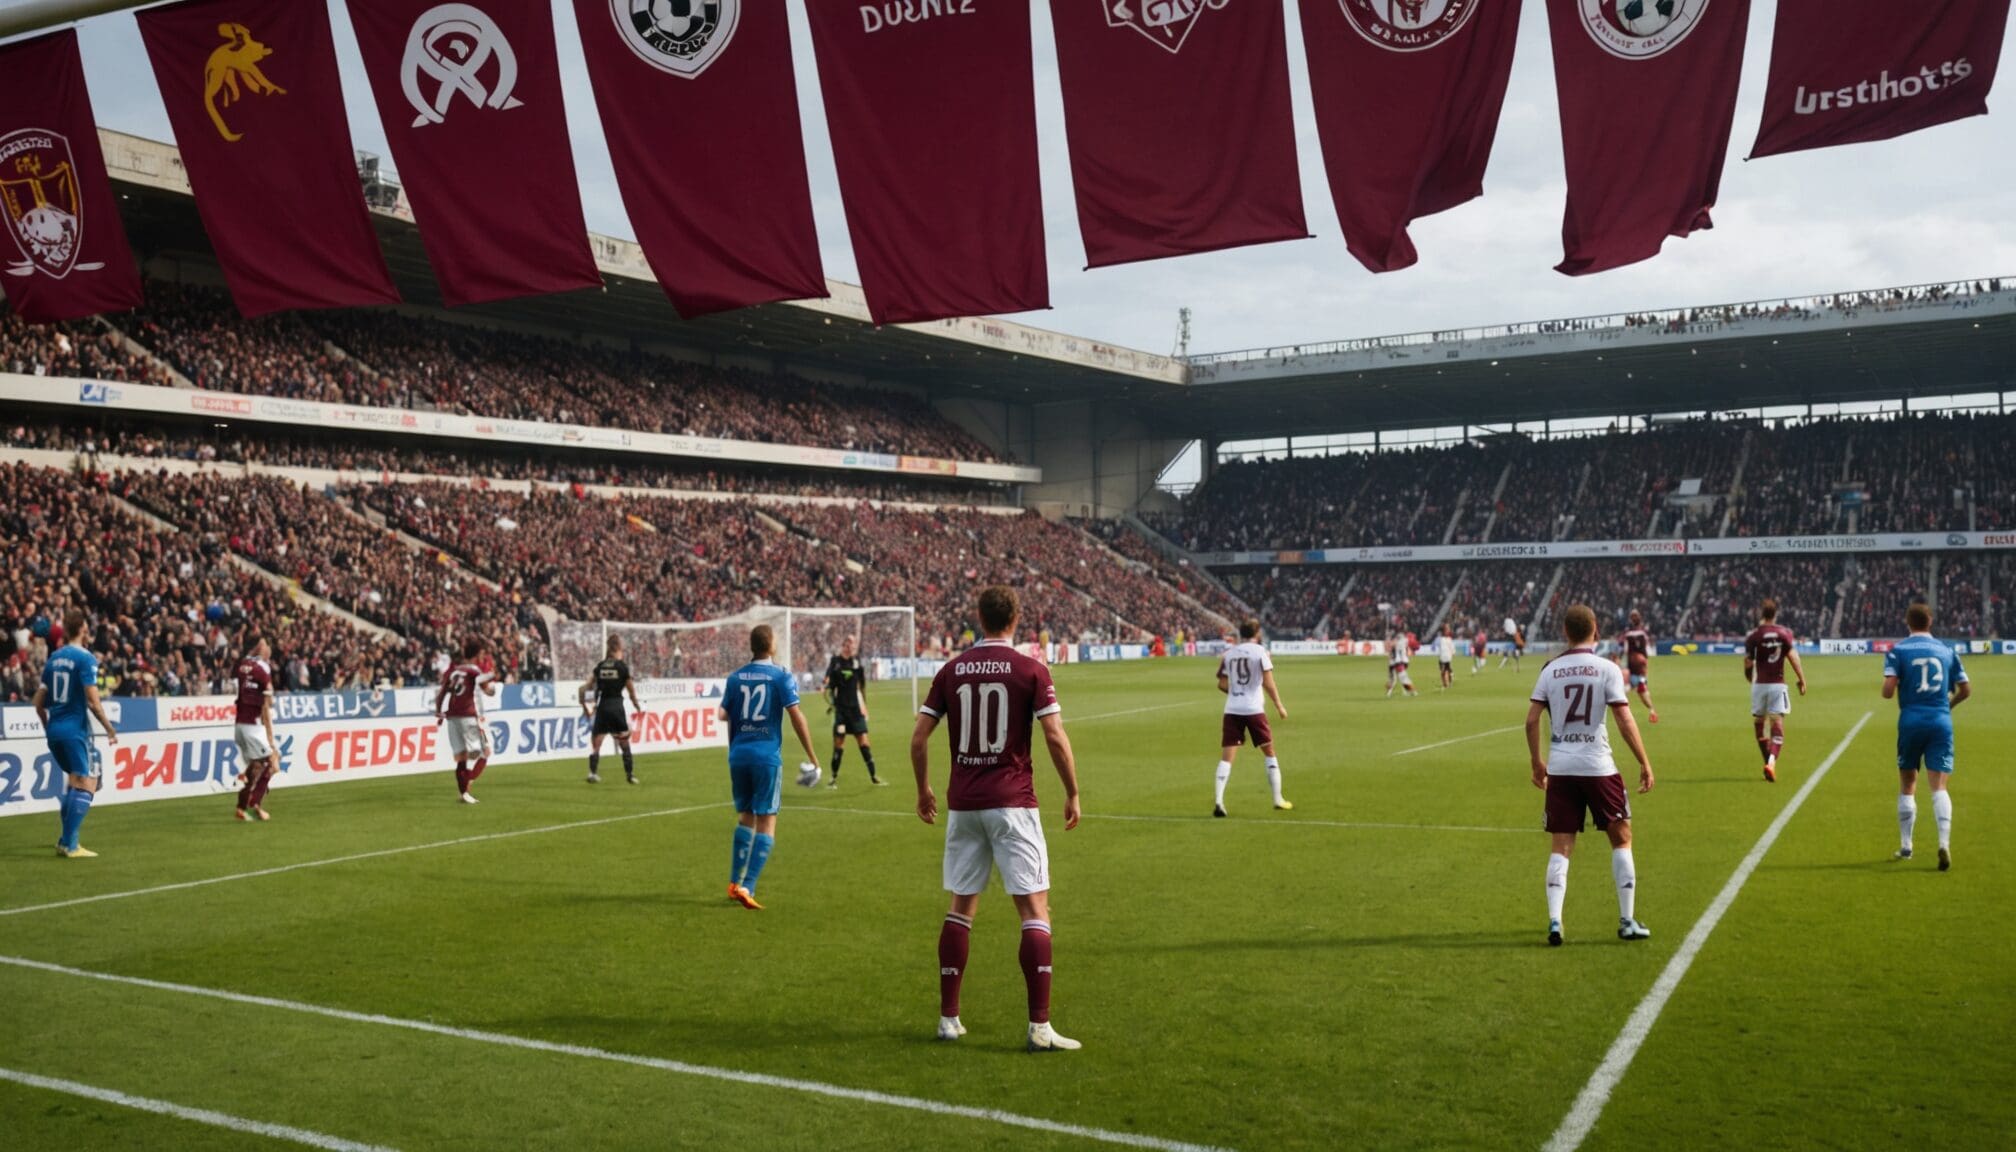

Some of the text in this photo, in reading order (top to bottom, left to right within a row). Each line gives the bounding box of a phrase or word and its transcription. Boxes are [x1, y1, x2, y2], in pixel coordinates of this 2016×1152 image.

[740, 684, 767, 721] 12
[956, 682, 1009, 753] 10
[1564, 684, 1594, 726] 21
